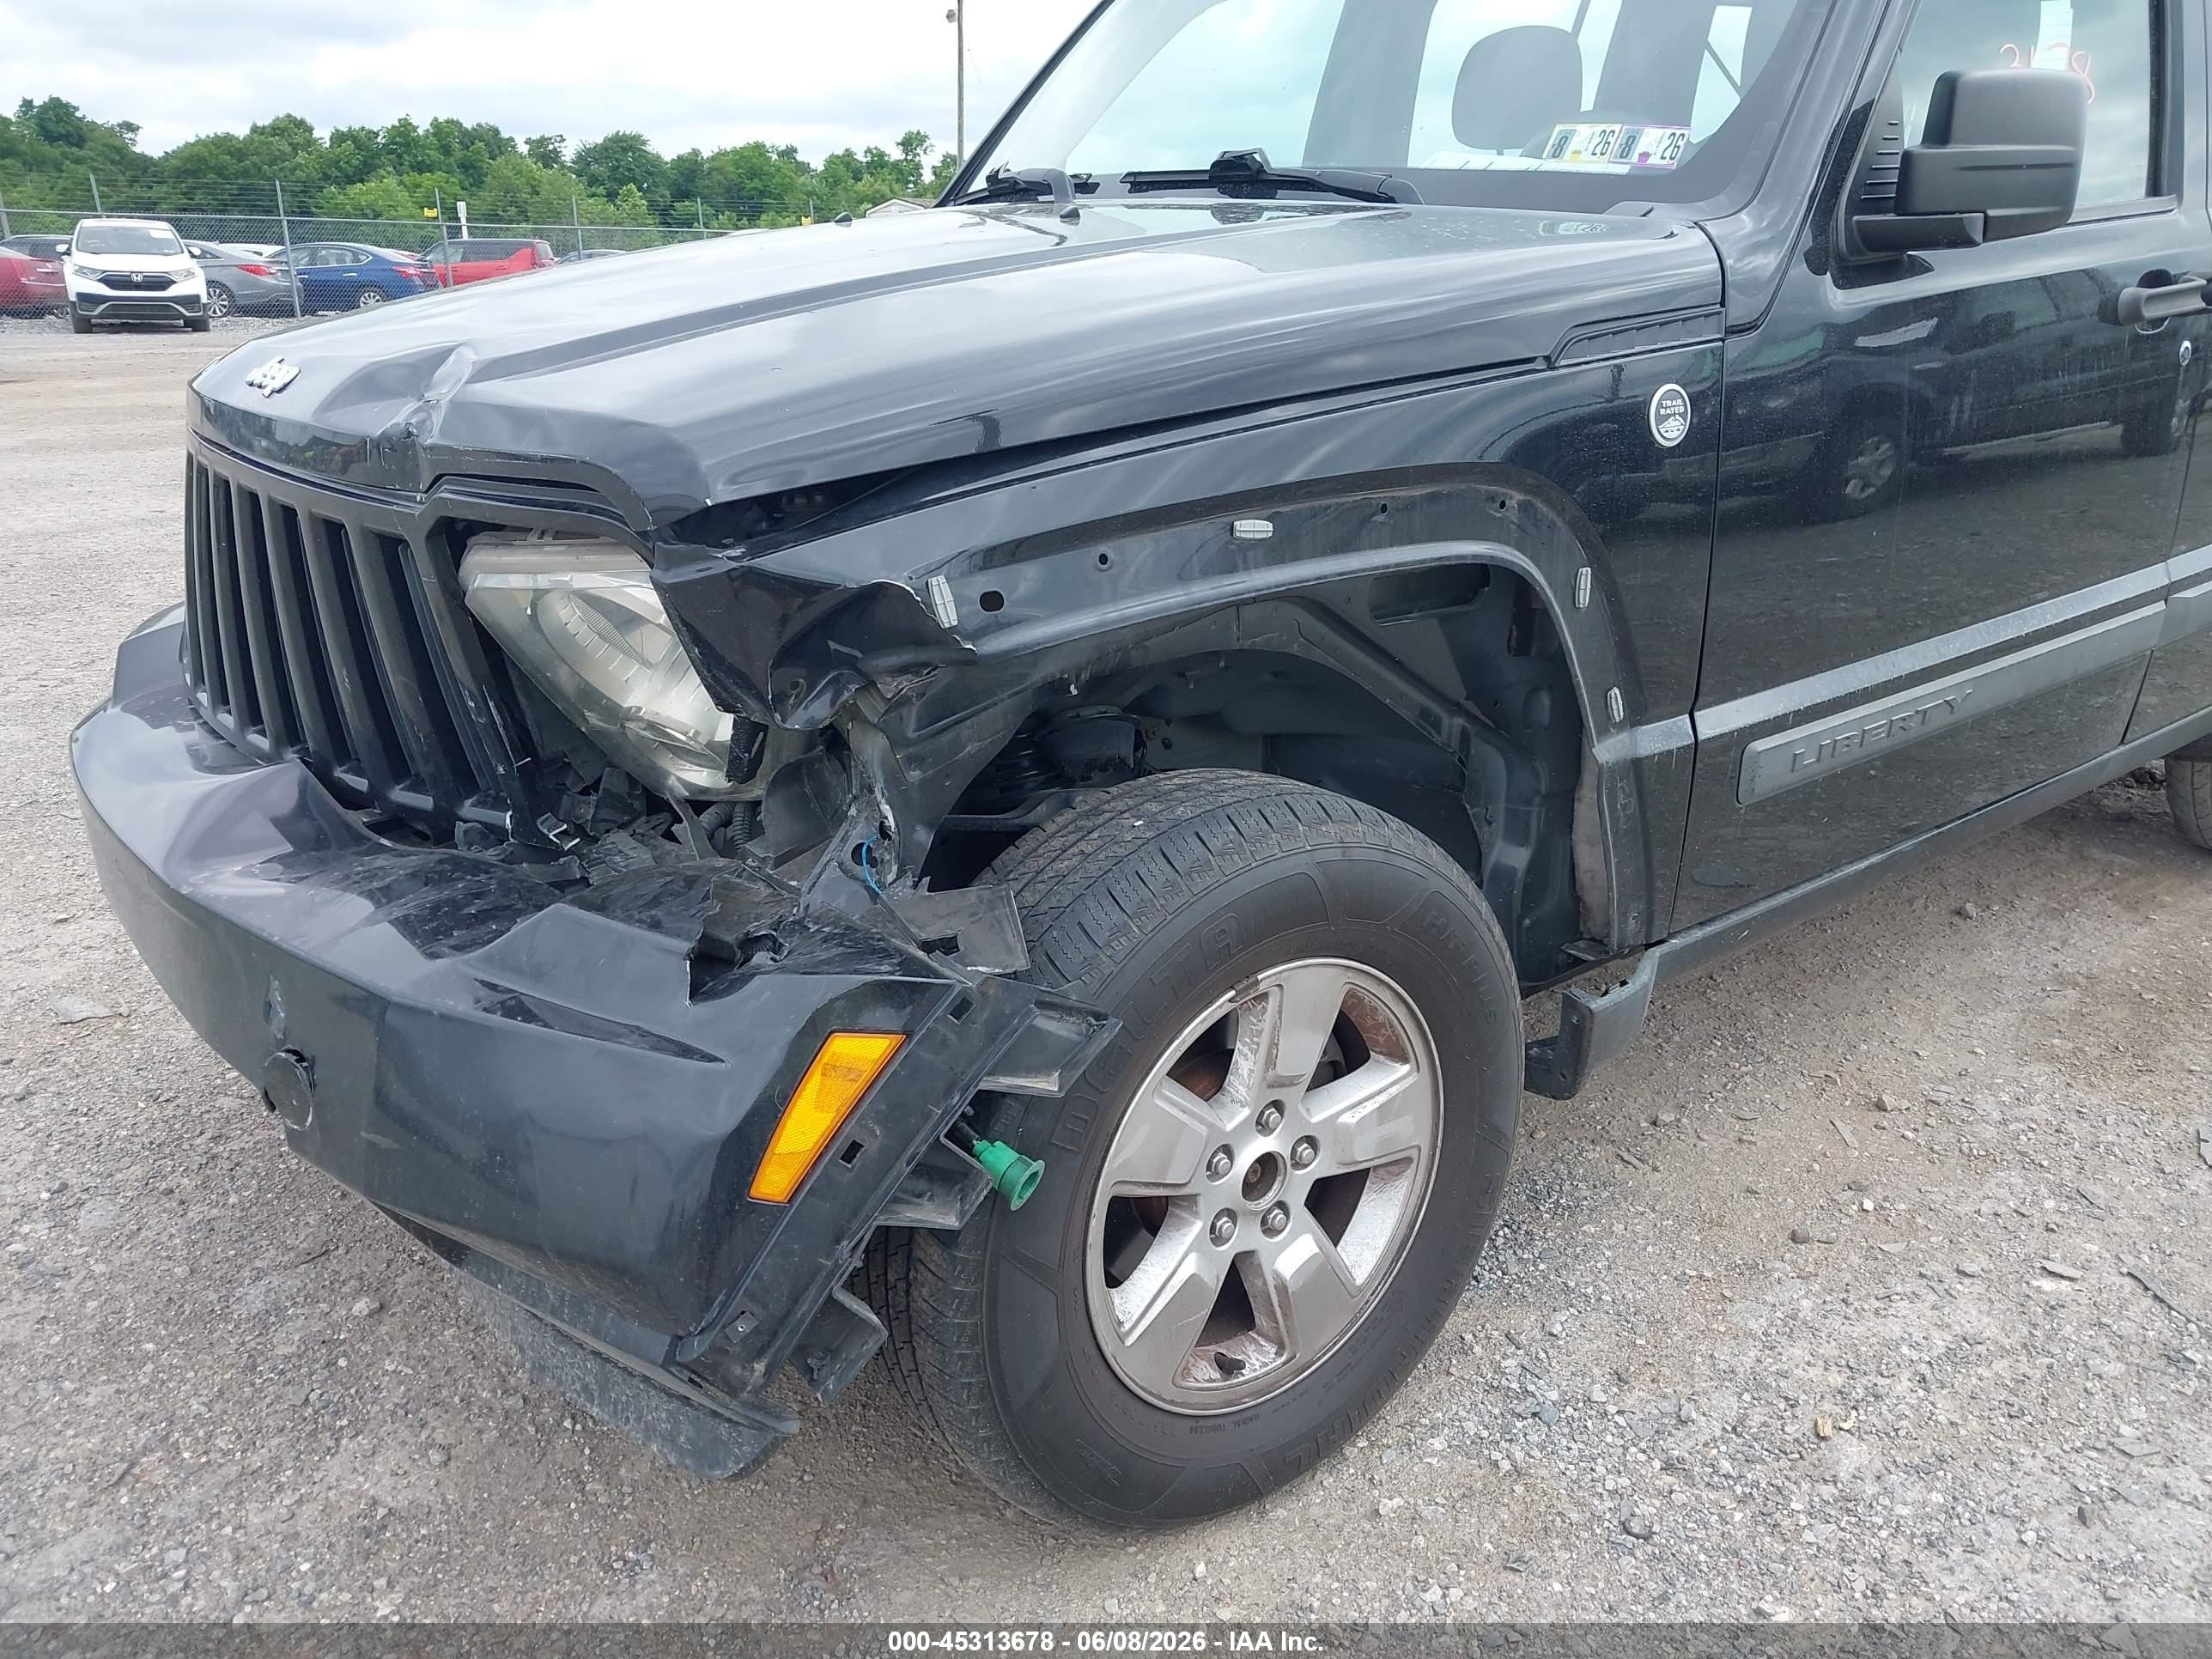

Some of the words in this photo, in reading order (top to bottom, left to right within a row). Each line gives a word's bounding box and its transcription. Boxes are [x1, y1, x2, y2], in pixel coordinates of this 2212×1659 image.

[1591, 130, 1615, 156] 26
[1659, 131, 1686, 161] 26
[1659, 406, 1685, 416] RATED
[1660, 398, 1684, 408] TRAIL
[1791, 690, 1972, 773] LIBERTY
